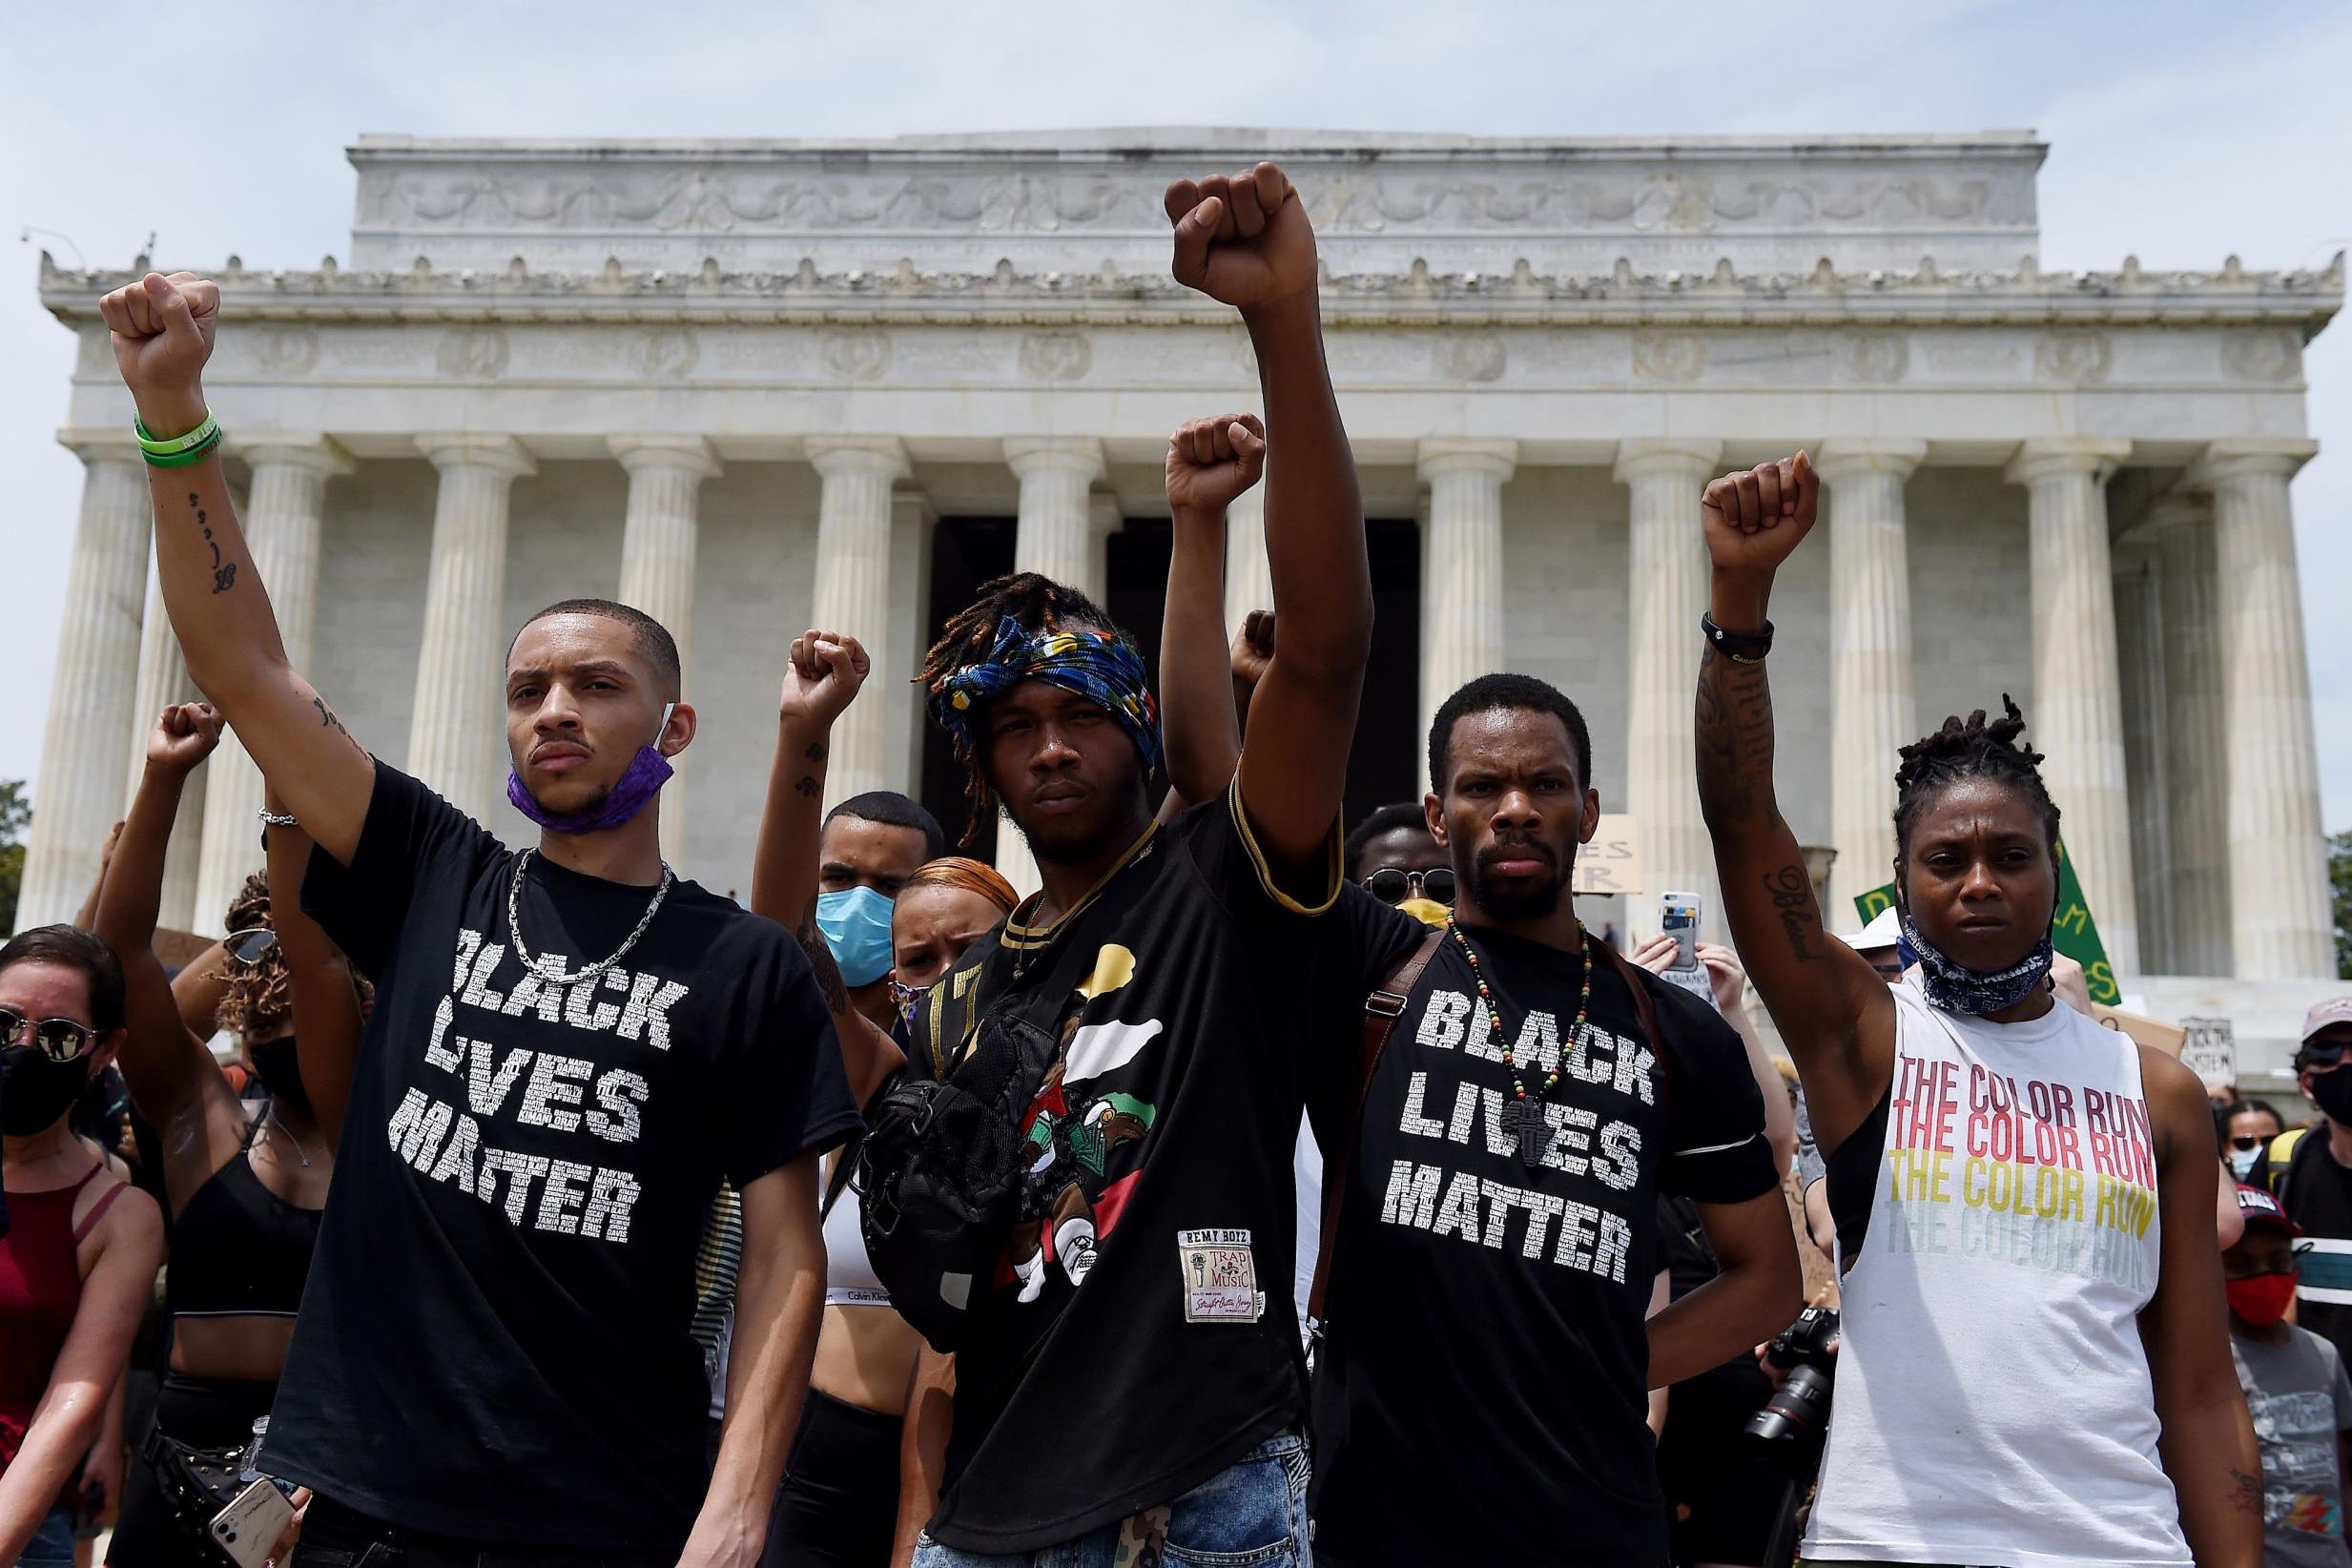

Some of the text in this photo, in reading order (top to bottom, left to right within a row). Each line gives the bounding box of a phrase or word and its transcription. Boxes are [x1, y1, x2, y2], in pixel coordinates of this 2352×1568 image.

[1415, 989, 1656, 1107] BLACK
[1899, 1052, 2150, 1140] THE COLOR RUN
[1893, 1099, 2156, 1192] THE COLOR RUN
[1186, 1230, 1218, 1243] REMY
[1381, 1160, 1632, 1284] MATTER
[1888, 1148, 2156, 1242] THE COLOR RUN
[848, 1291, 871, 1301] Calvin
[1210, 1250, 1247, 1268] TRAP
[1211, 1269, 1248, 1288] MUSIC
